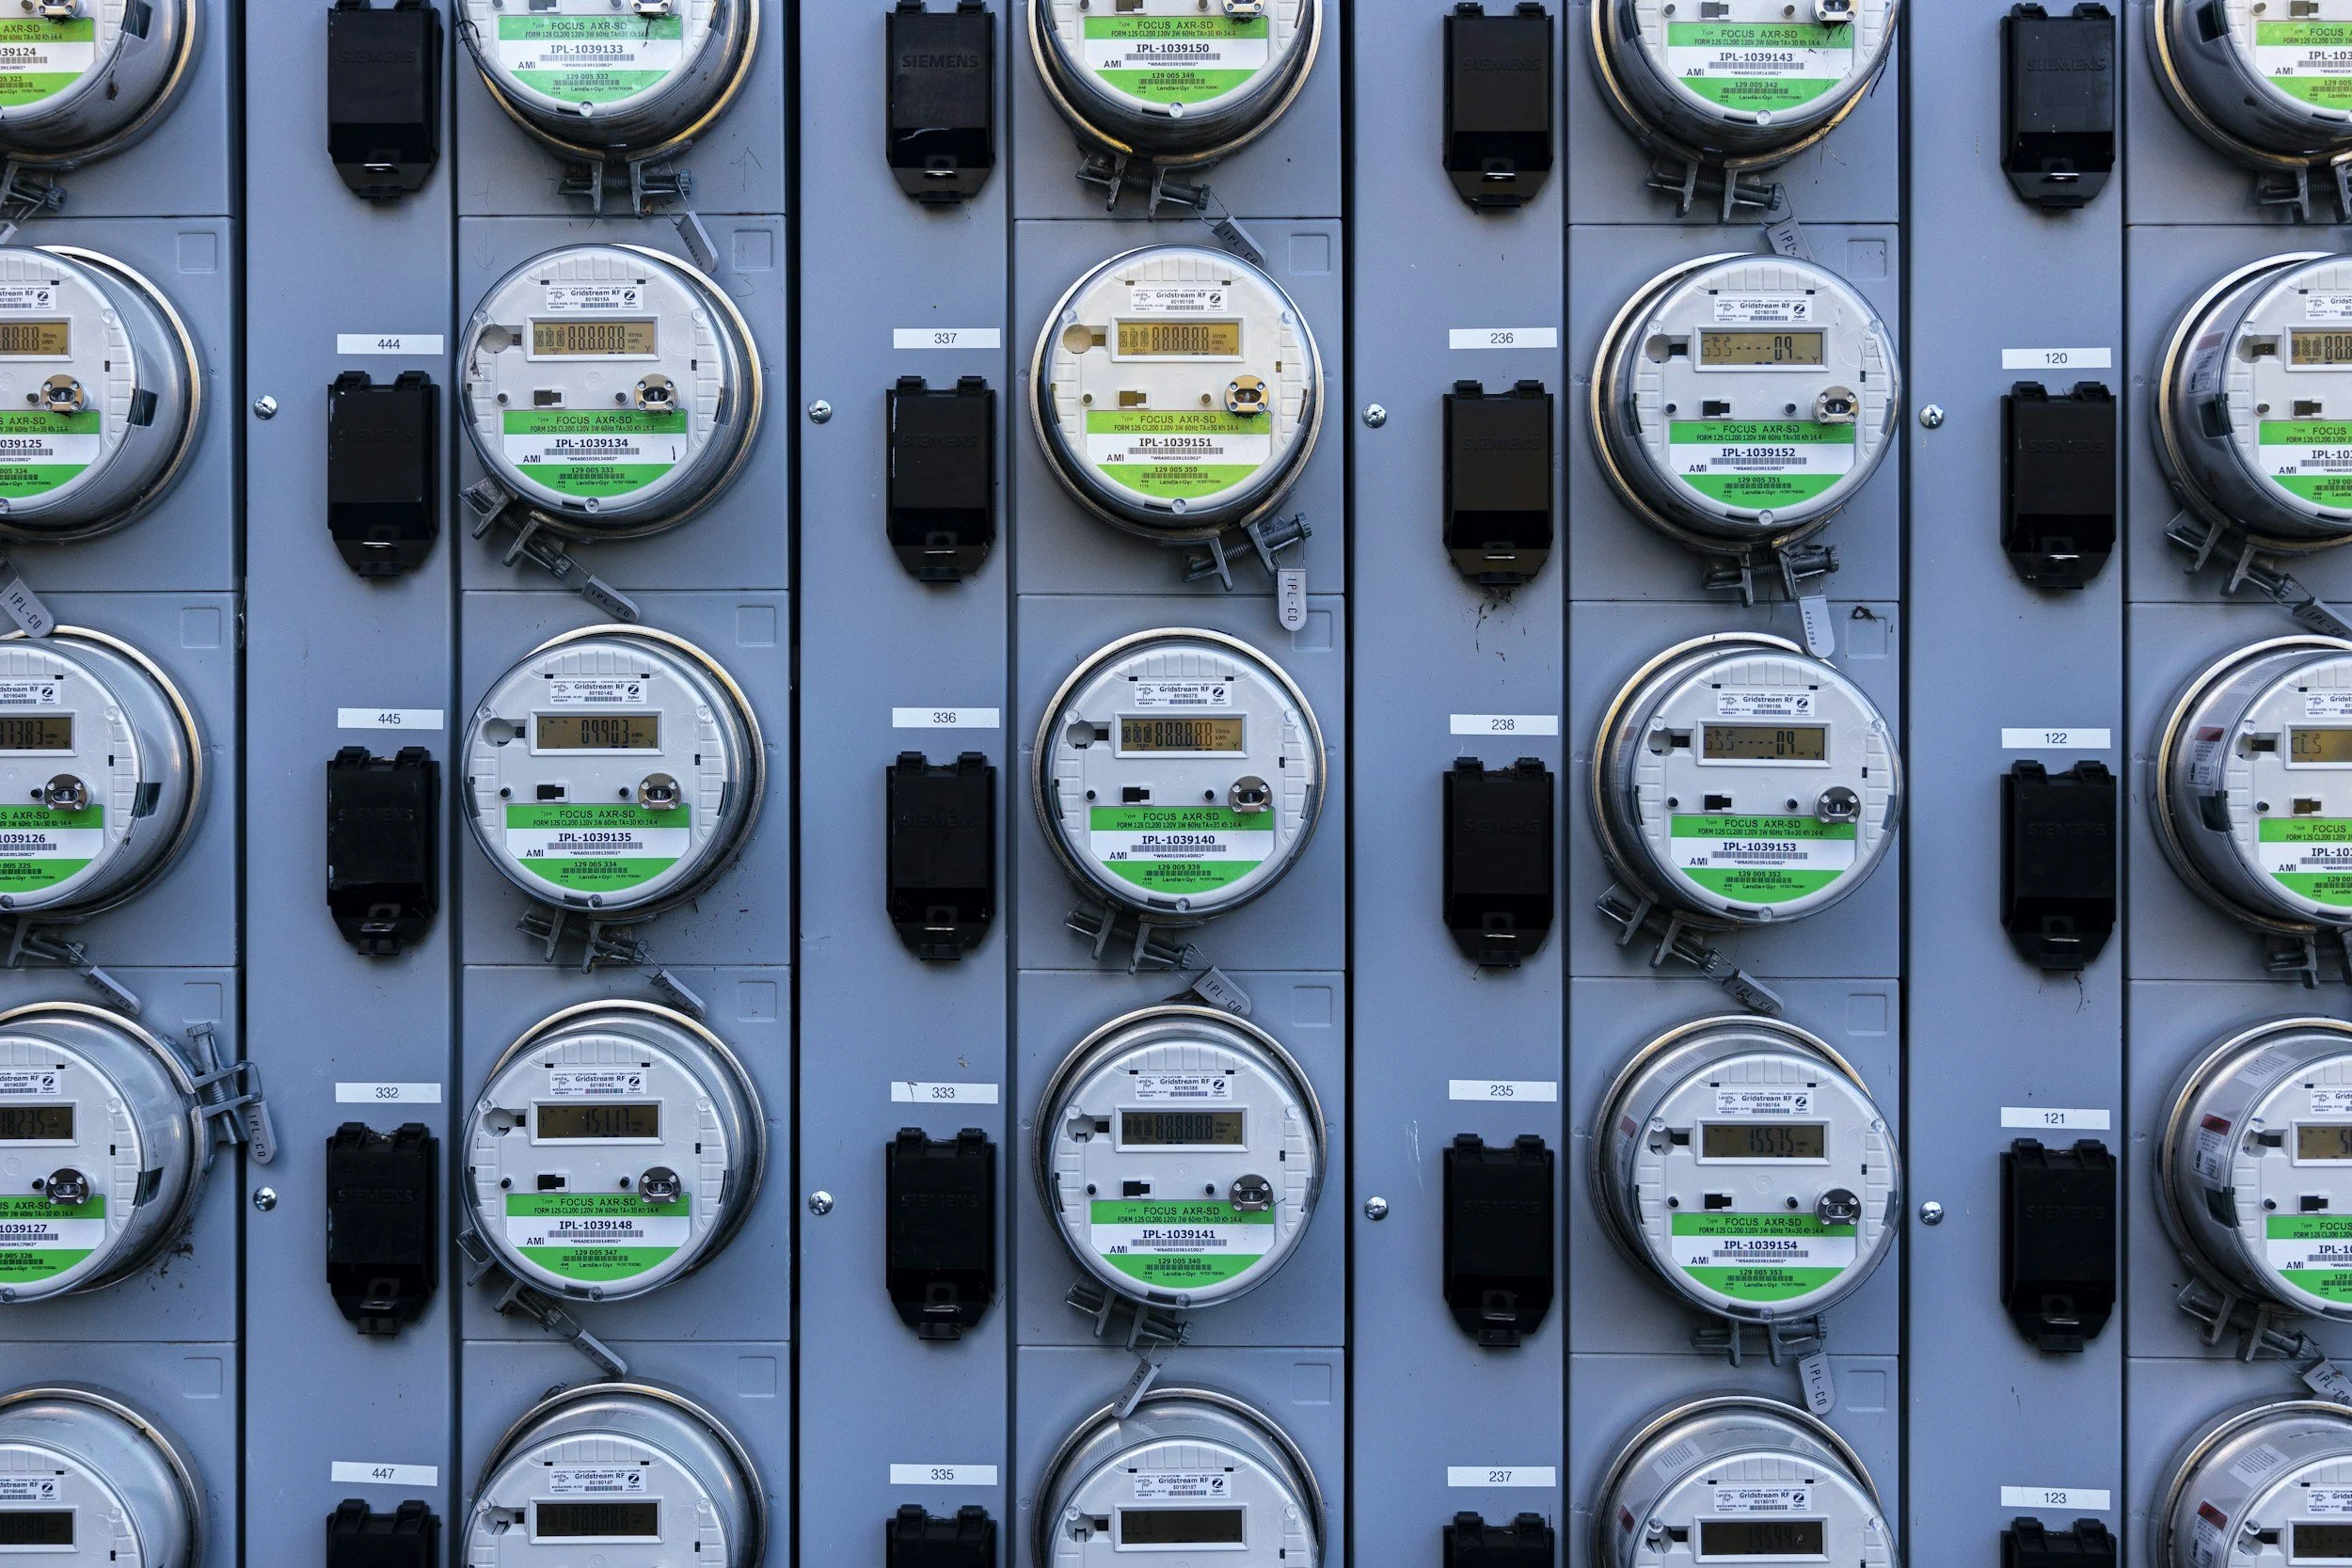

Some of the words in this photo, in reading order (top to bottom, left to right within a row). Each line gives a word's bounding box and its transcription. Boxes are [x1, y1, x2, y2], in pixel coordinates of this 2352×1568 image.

[3, 24, 40, 33] AXR-SD
[551, 22, 585, 30] FOCUS
[590, 22, 628, 30] AXR-SD
[1137, 21, 1171, 29] FOCUS
[1176, 21, 1214, 29] AXR-SD
[1760, 30, 1798, 39] AXR-SD
[550, 45, 624, 54] IPL-1039133
[1136, 44, 1210, 53] IPL-1039150
[1720, 53, 1793, 61] IPL-1039143
[517, 61, 536, 70] AMI
[900, 55, 979, 69] SIEMENS
[2026, 57, 2106, 72] SIEMENS
[1224, 230, 1258, 264] IPL-CO
[935, 333, 956, 343] 337
[1491, 333, 1513, 343] 236
[378, 340, 400, 349] 444
[2046, 353, 2067, 363] 120
[9, 417, 46, 425] AXR-SD
[556, 416, 590, 424] FOCUS
[596, 416, 632, 424] AXR-SD
[555, 439, 628, 448] IPL-1039134
[1139, 438, 1212, 447] IPL-1039151
[1722, 448, 1795, 457] IPL-1039152
[1287, 578, 1298, 622] IPL-CO
[9, 592, 42, 630] IPL-CO
[378, 714, 400, 724] 445
[933, 712, 956, 722] 336
[1492, 720, 1514, 730] 238
[2045, 733, 2066, 743] 122
[560, 810, 593, 818] FOCUS
[598, 810, 636, 818] AXR-SD
[1724, 819, 1758, 828] FOCUS
[2312, 825, 2346, 833] FOCUS
[558, 833, 631, 842] IPL-1039135
[1142, 835, 1216, 845] IPL-1039140
[1723, 843, 1796, 851] IPL-1039153
[2279, 863, 2296, 872] AMI
[1205, 980, 1242, 1012] IPL-CO
[377, 1087, 399, 1098] 332
[931, 1087, 954, 1098] 333
[1491, 1085, 1513, 1096] 235
[2044, 1113, 2063, 1123] 121
[248, 1115, 266, 1158] IPL-CO
[14, 1201, 52, 1210] AXR-SD
[1144, 1207, 1177, 1215] FOCUS
[1183, 1207, 1219, 1215] AXR-SD
[559, 1221, 632, 1229] IPL-1039148
[1725, 1217, 1758, 1226] FOCUS
[1765, 1218, 1802, 1227] AXR-SD
[2320, 1222, 2352, 1230] FOCUS
[1142, 1230, 1216, 1239] IPL-1039141
[1110, 1245, 1128, 1254] AMI
[1724, 1241, 1797, 1250] IPL-1039154
[1809, 1363, 1827, 1406] IPL-CO
[373, 1468, 394, 1480] 447
[931, 1469, 953, 1480] 335
[1489, 1471, 1512, 1481] 237
[2043, 1493, 2067, 1503] 123
